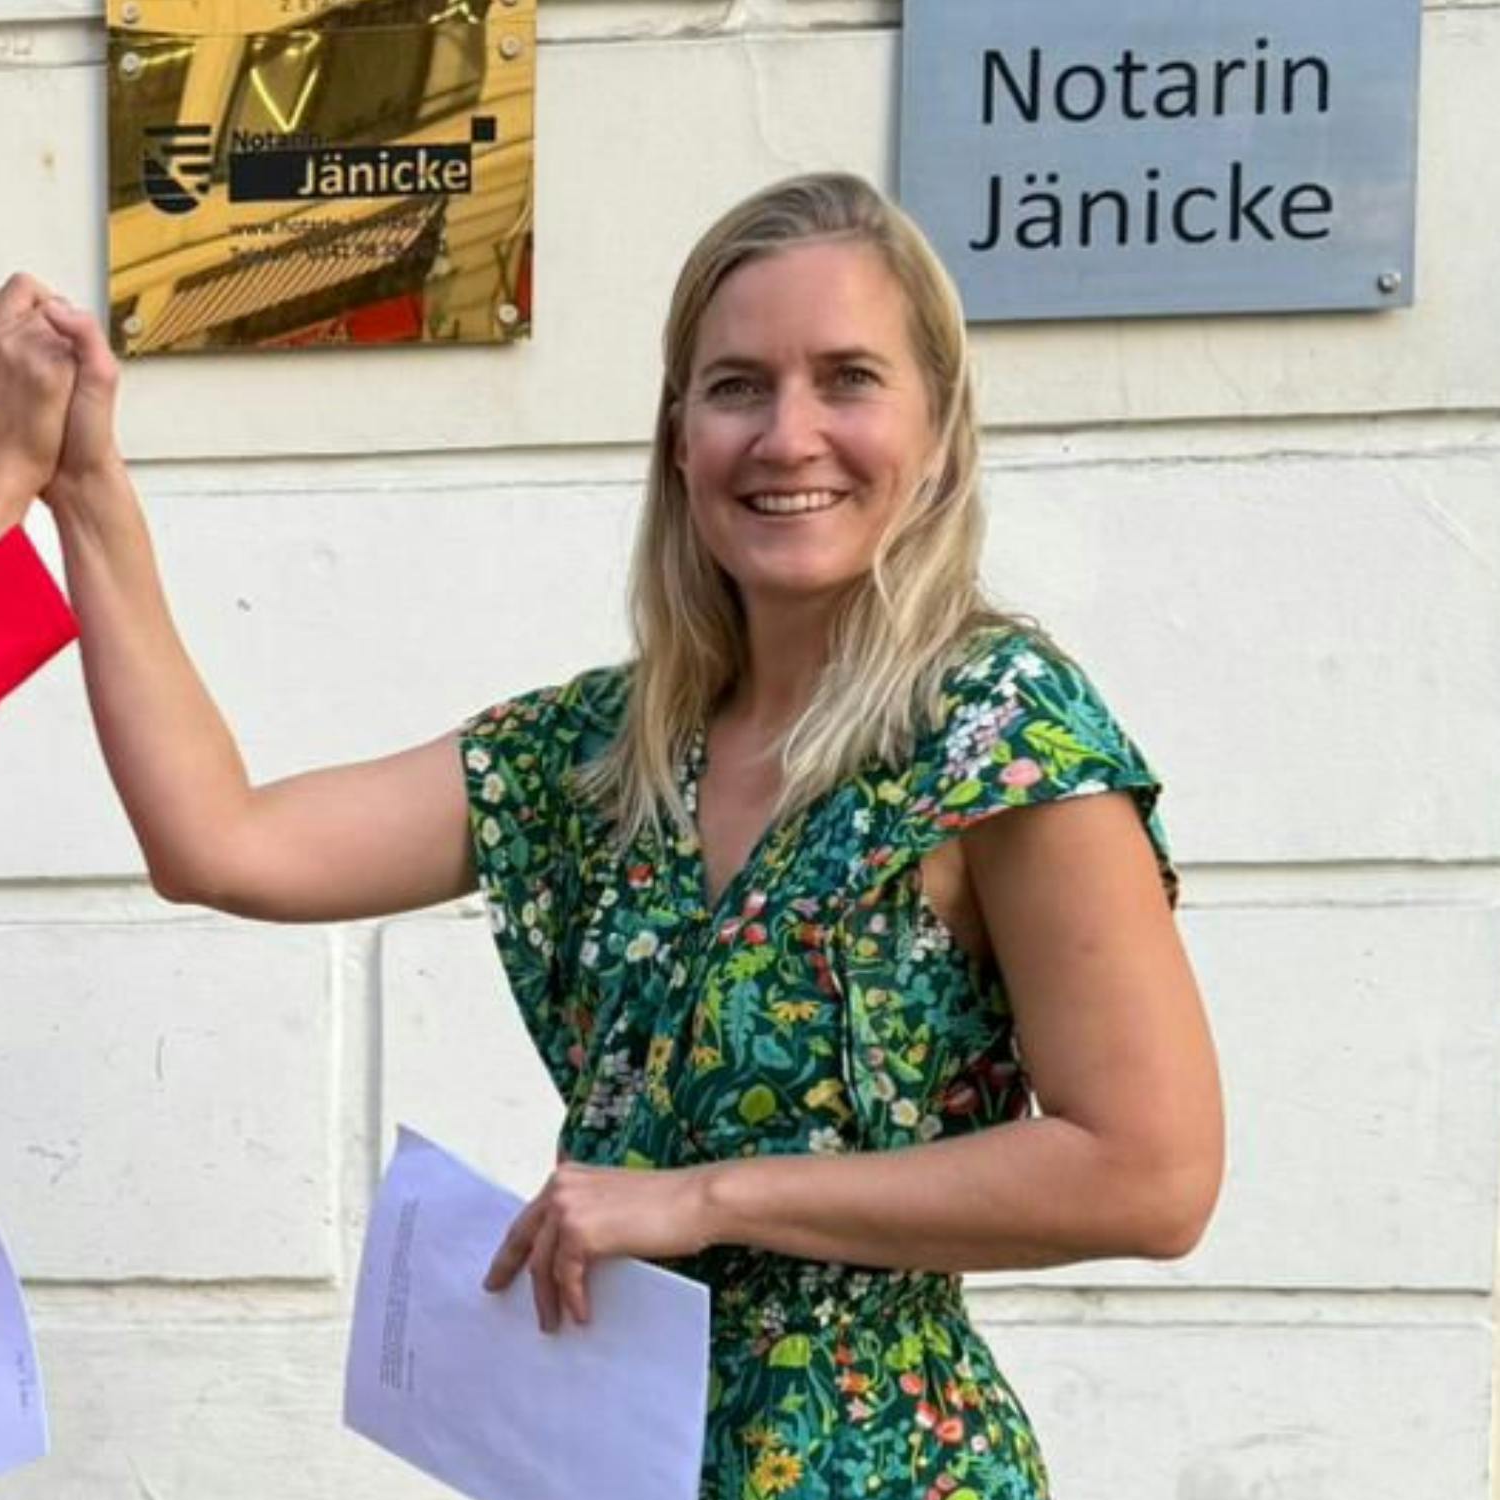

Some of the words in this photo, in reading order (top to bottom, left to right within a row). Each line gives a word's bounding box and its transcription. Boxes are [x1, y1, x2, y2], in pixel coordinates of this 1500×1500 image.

[981, 37, 1330, 124] Notarin
[297, 148, 469, 196] Jänicke
[968, 161, 1334, 251] Jänicke
